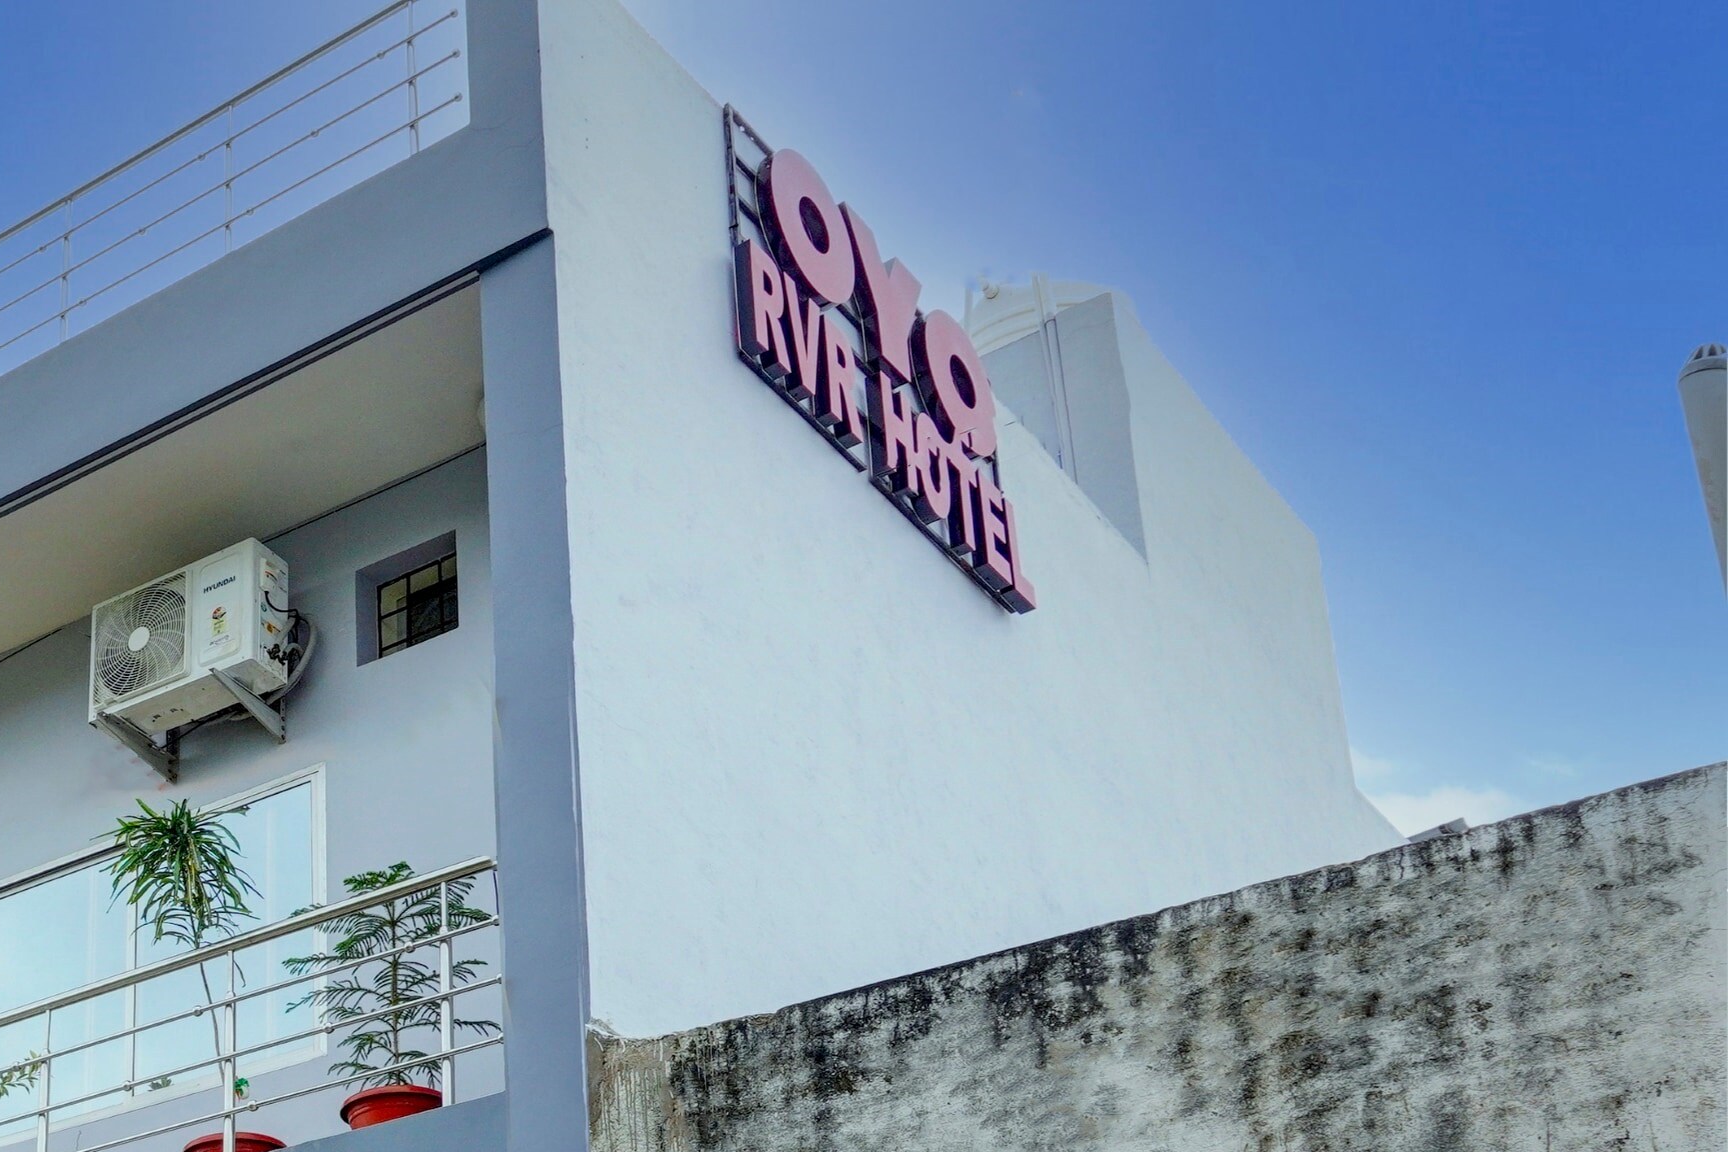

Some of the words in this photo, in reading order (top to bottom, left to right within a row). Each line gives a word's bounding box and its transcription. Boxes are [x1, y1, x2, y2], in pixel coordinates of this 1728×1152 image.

[736, 238, 862, 450] RVR
[867, 370, 1036, 614] HOTEL
[756, 148, 998, 458] OYO
[203, 575, 237, 594] HYUNDAI
